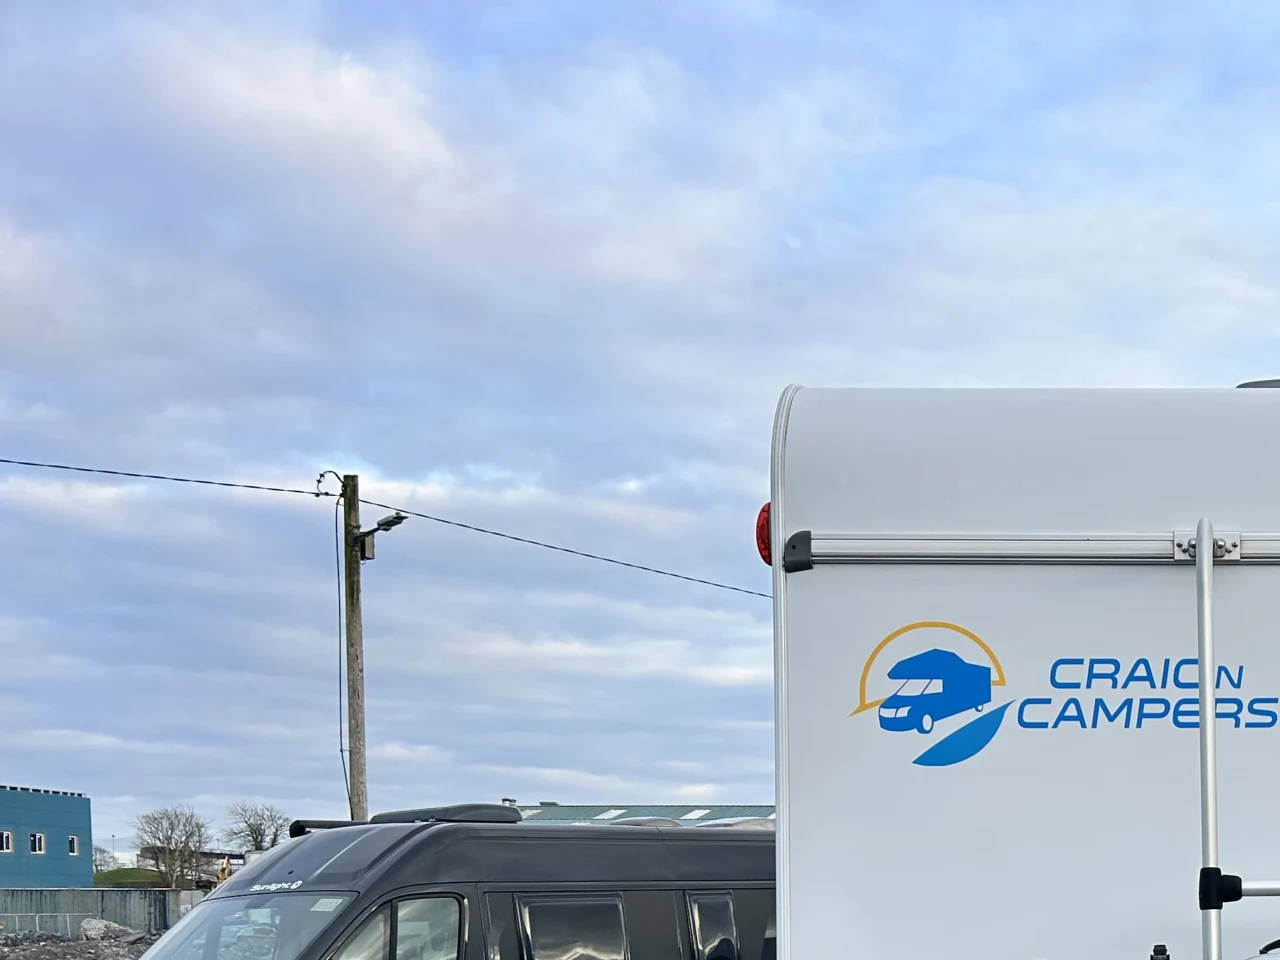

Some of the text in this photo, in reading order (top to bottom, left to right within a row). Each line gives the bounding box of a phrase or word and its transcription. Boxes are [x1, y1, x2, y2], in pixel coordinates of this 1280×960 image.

[1050, 658, 1244, 689] CRAIC N
[1018, 697, 1279, 729] CAMPERS
